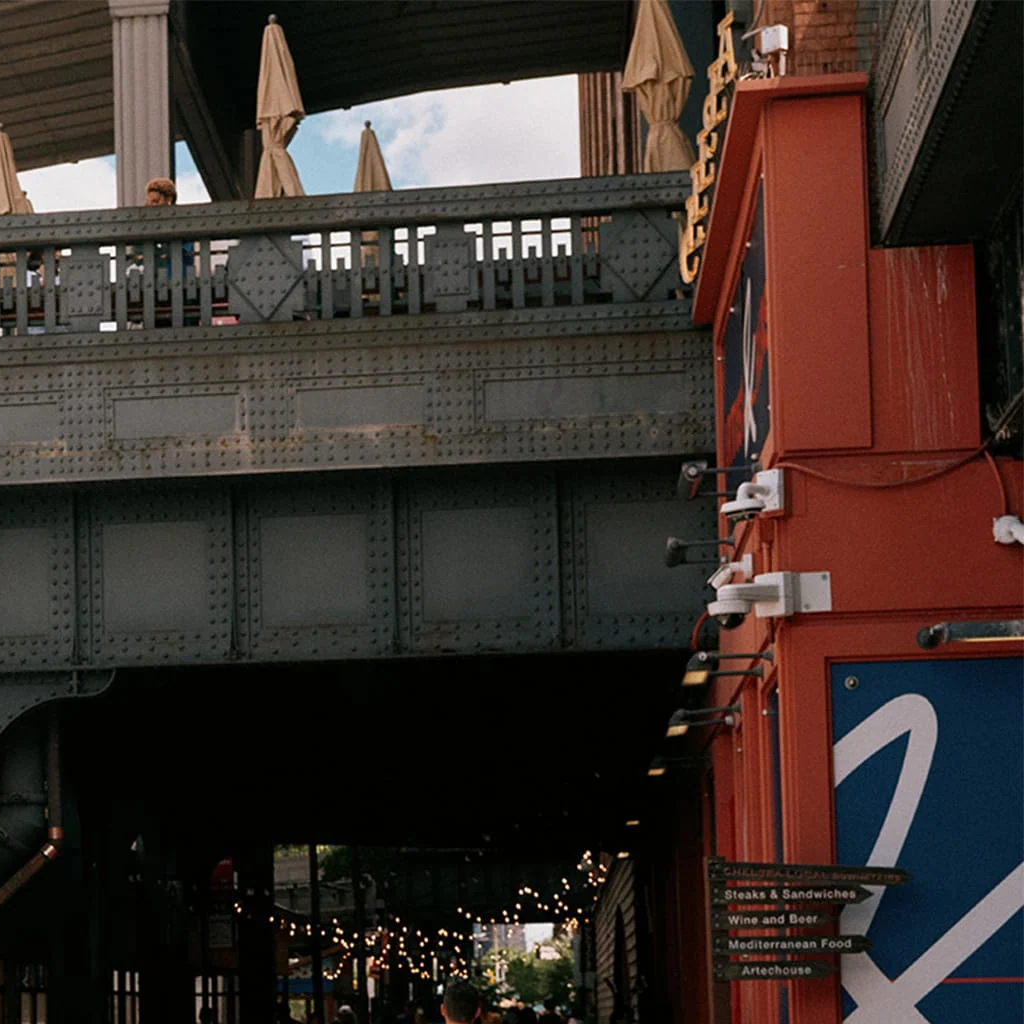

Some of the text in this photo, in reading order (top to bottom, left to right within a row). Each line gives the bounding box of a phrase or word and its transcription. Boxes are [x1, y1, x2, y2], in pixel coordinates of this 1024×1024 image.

[724, 888, 856, 900] Steaks & Sandwiches
[728, 913, 818, 925] Wine and Beer
[728, 938, 852, 950] Mediterranean Food
[742, 965, 812, 976] Artechouse
